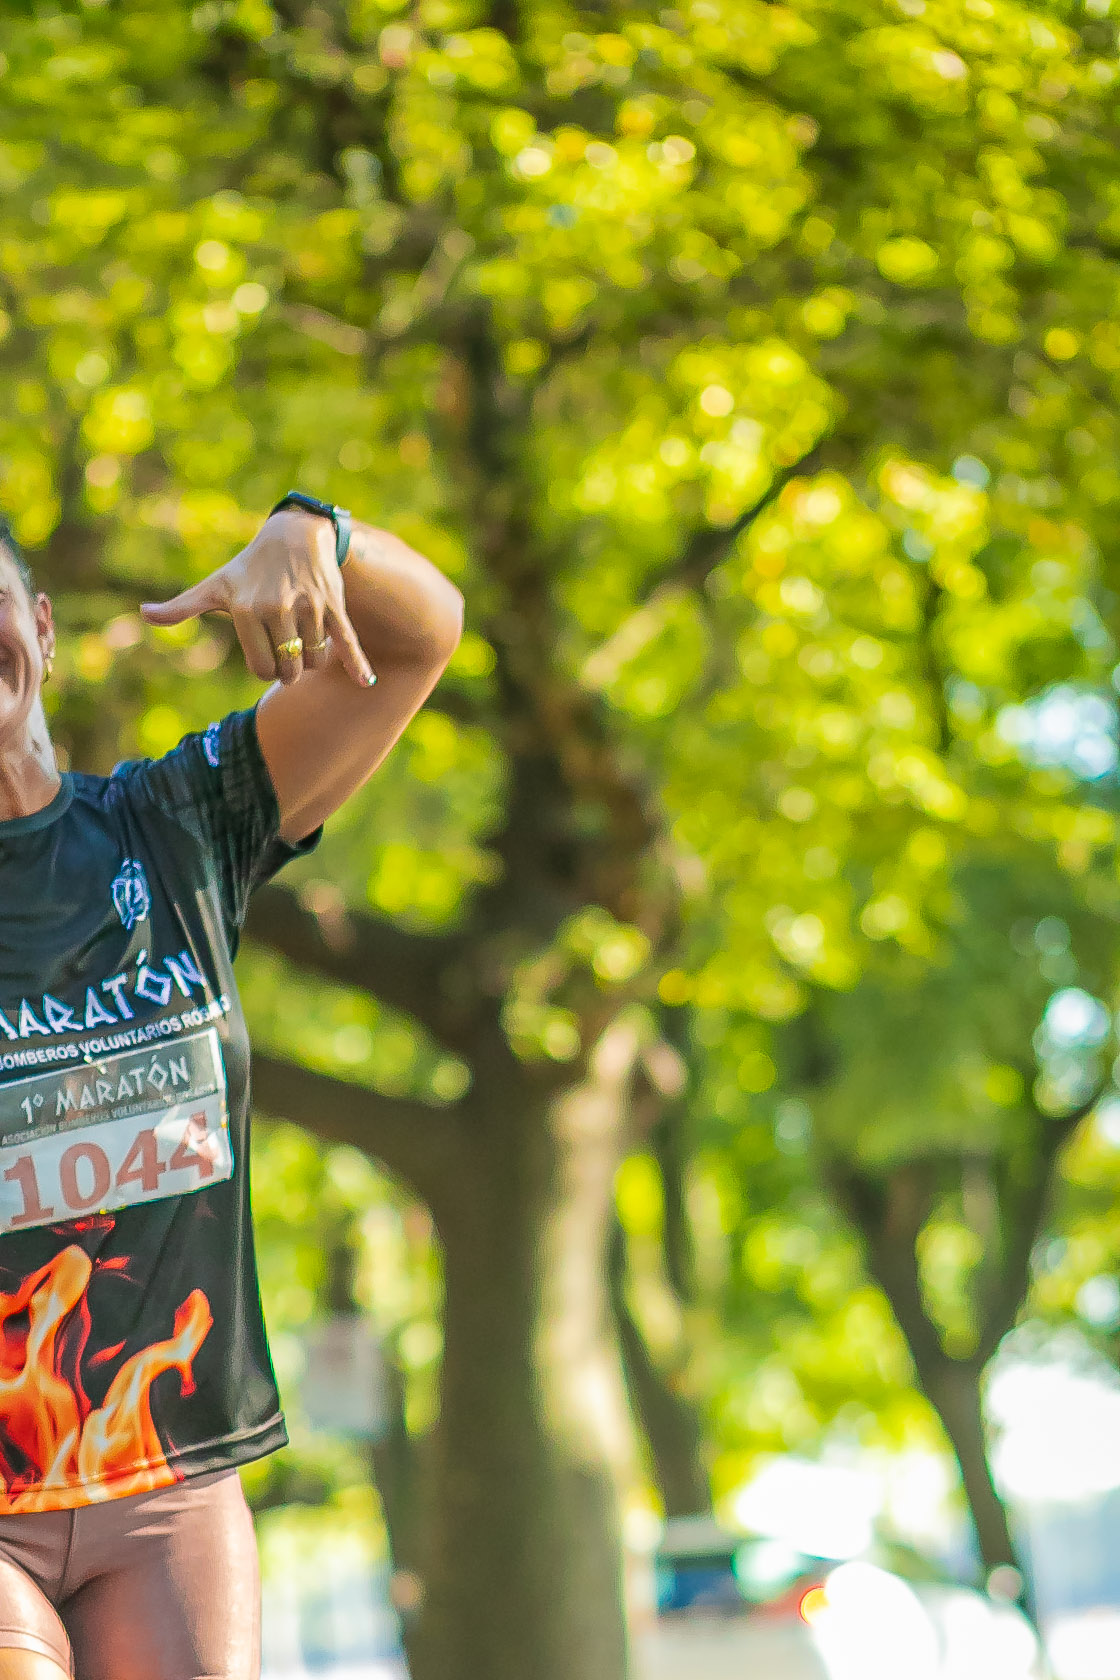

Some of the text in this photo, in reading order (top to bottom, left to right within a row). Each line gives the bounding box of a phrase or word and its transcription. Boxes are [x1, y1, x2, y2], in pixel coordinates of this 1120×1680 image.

[79, 1016, 182, 1054] VOLUNTARIOS
[56, 1055, 190, 1117] MARATÓN
[3, 1110, 215, 1226] 1044
